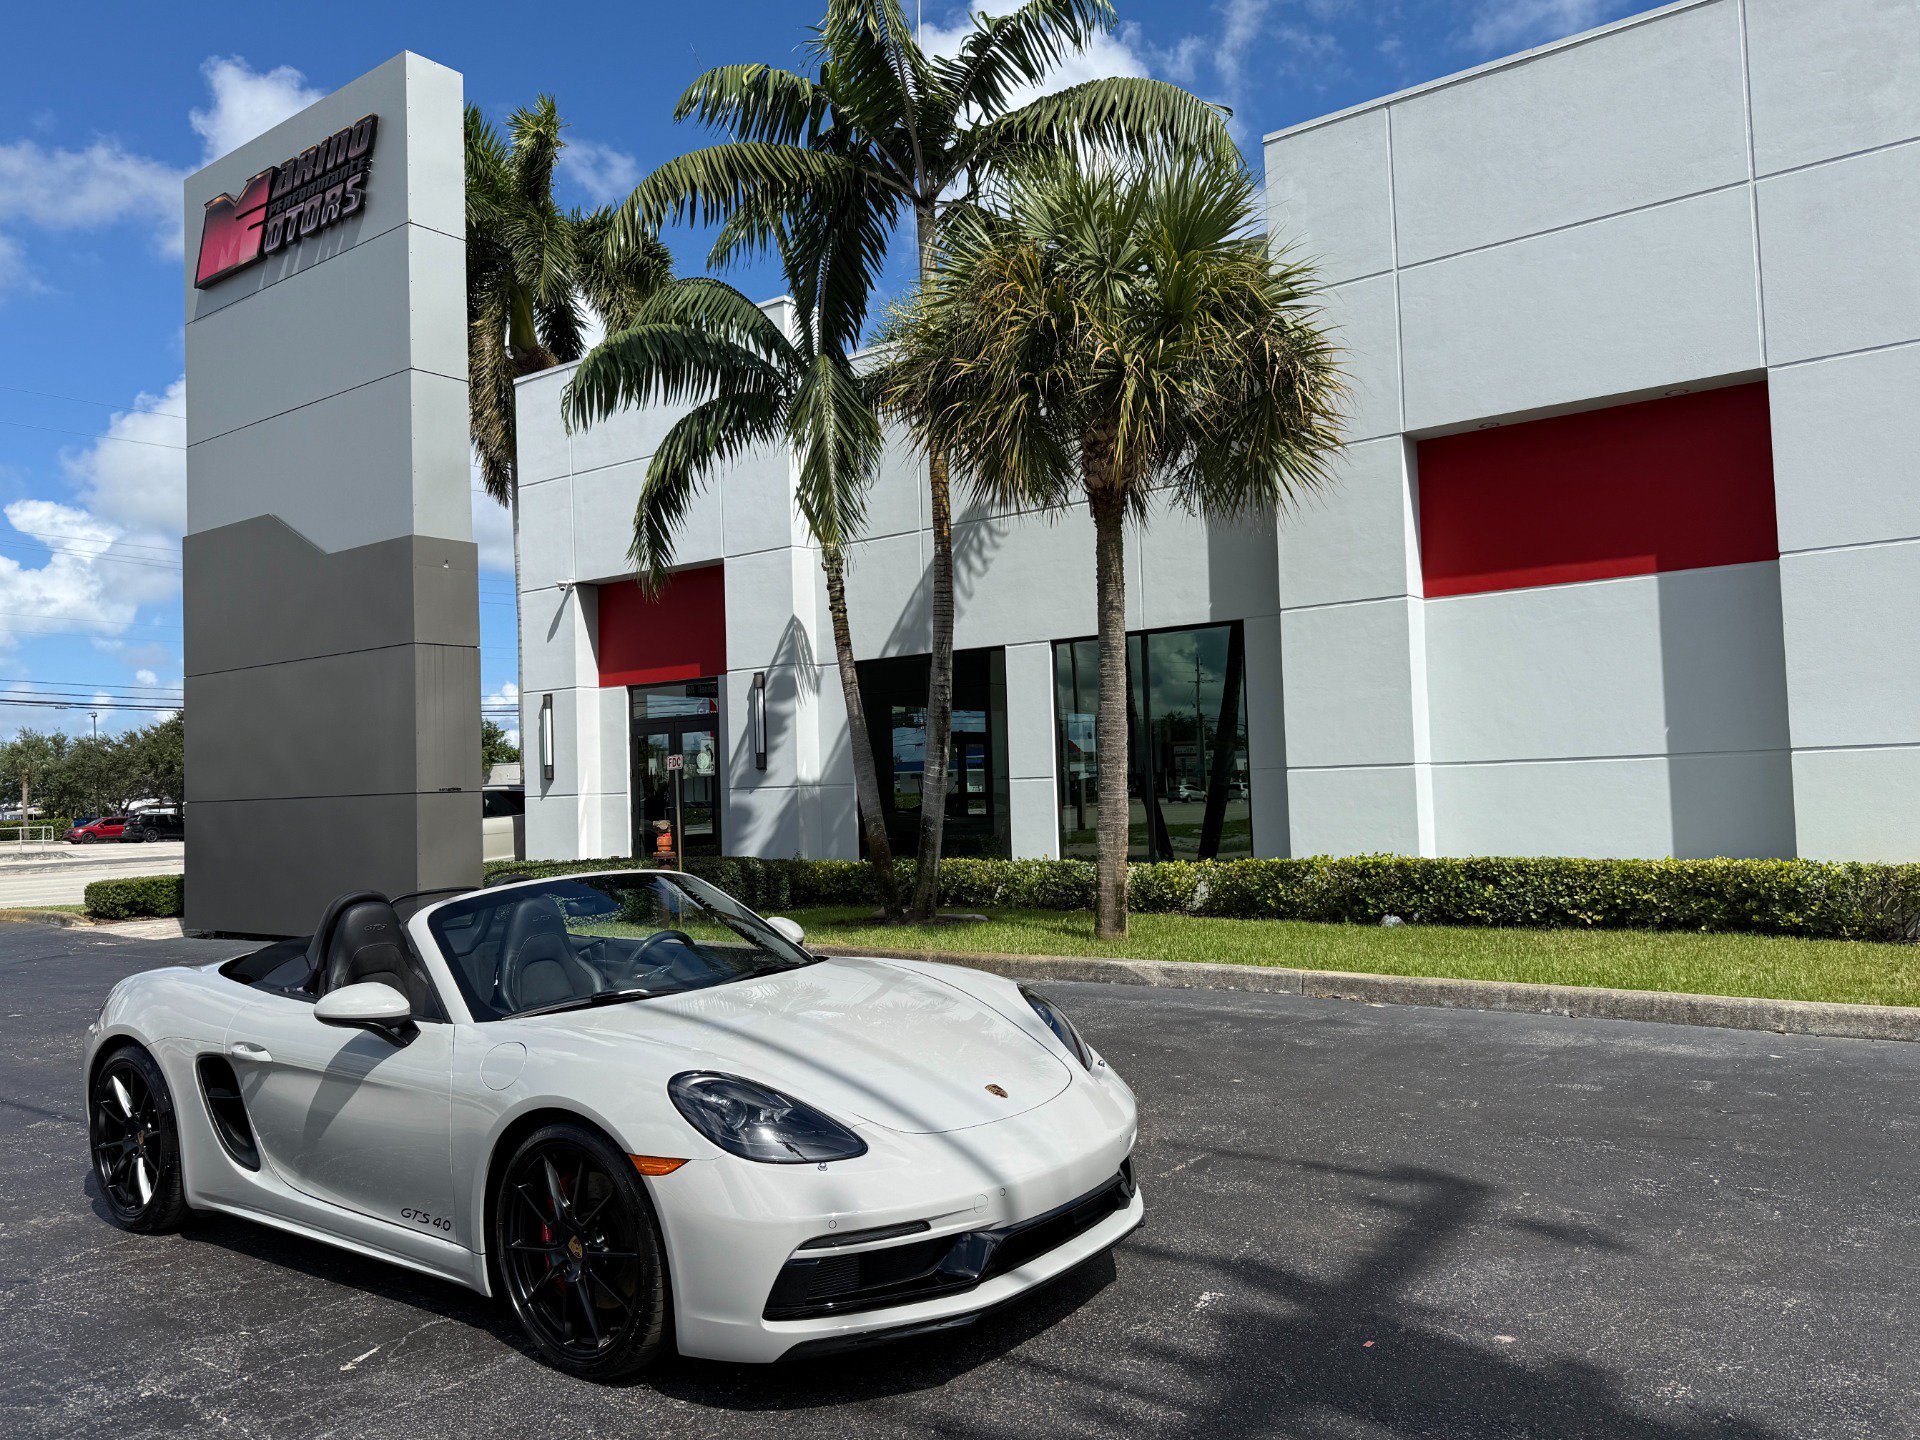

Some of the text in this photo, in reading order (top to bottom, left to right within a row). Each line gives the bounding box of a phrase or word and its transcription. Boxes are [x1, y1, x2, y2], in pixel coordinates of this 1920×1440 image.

[668, 757, 681, 768] FDC
[401, 1208, 451, 1231] GTS 4.0
